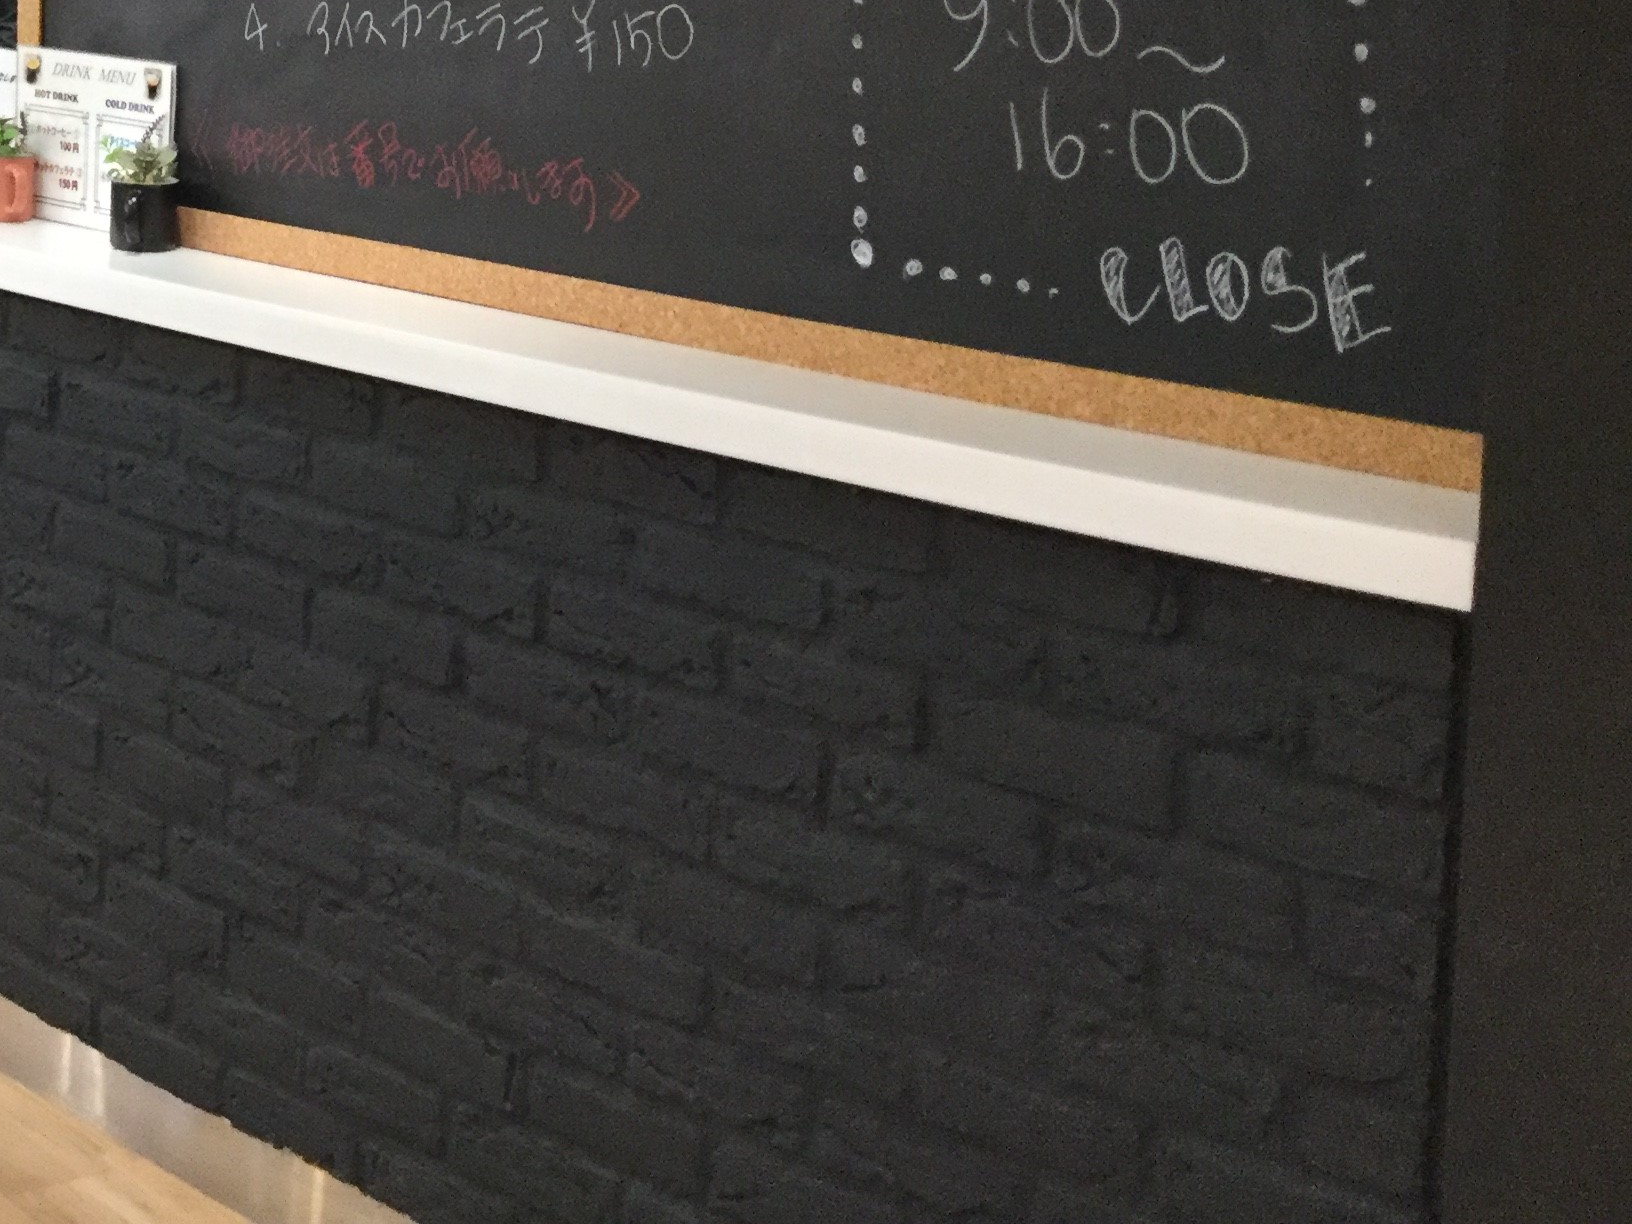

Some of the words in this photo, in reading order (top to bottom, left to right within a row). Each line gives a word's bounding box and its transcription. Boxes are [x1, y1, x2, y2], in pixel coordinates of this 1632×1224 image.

[52, 62, 92, 81] DRINK
[98, 68, 137, 86] MENU
[34, 89, 50, 100] HOT
[52, 91, 79, 104] DRINK
[105, 99, 127, 110] COLD
[128, 103, 155, 115] DRINK
[1009, 87, 1250, 185] 16:00
[1100, 237, 1392, 353] CLOSE
